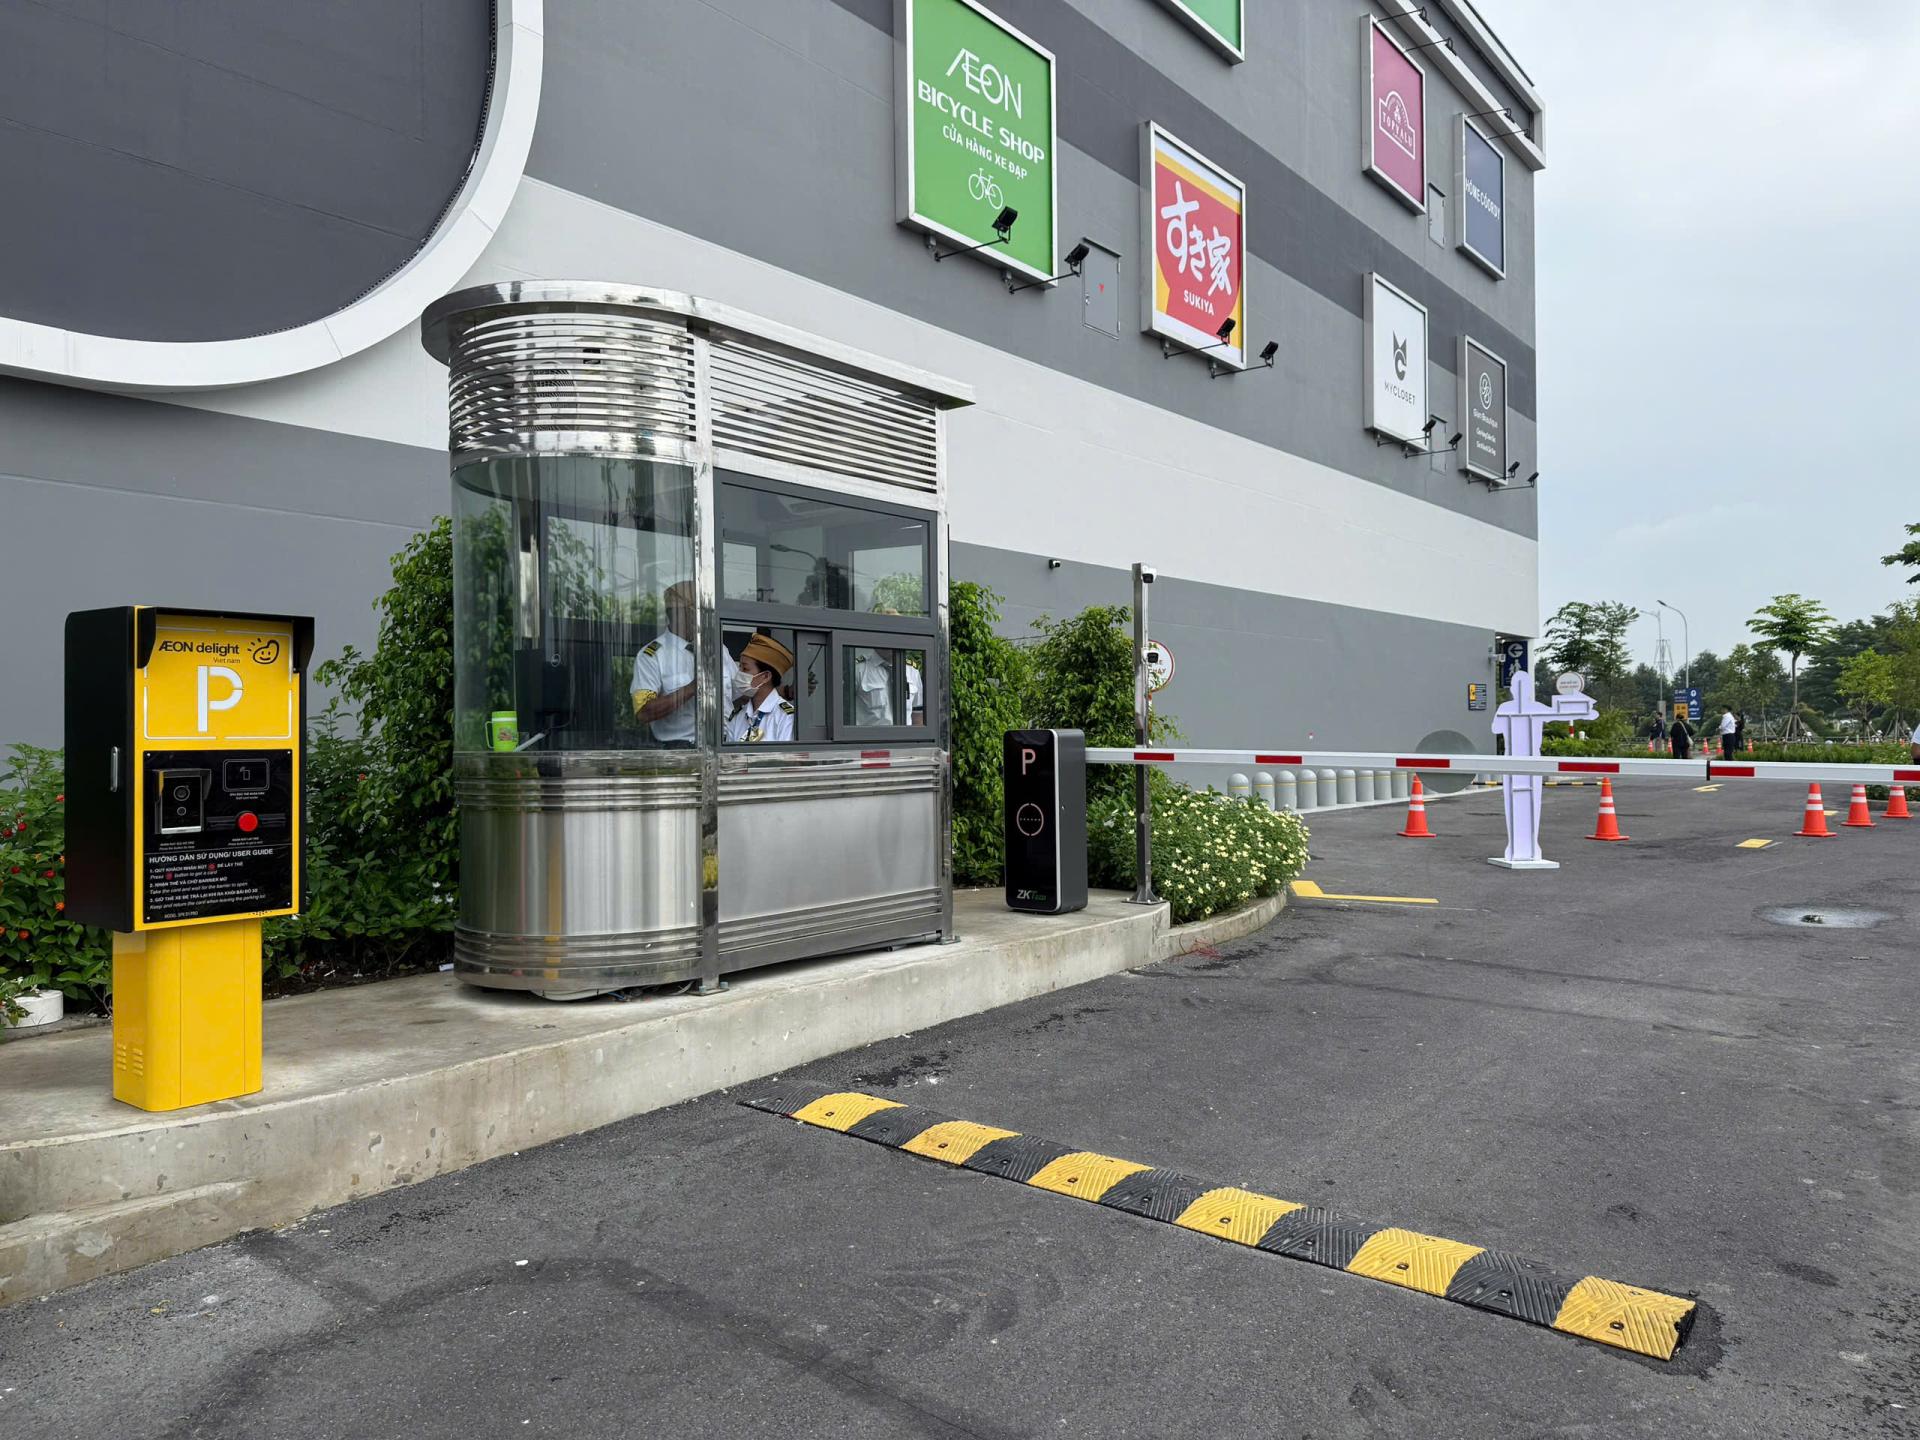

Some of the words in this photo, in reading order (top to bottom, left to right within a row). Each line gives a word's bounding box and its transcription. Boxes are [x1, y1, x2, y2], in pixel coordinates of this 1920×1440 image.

[918, 79, 993, 138] BICYCLE
[999, 128, 1045, 164] SHOP
[942, 124, 963, 146] CỬA
[966, 138, 992, 161] HÀNG
[994, 153, 1006, 170] XE
[1008, 162, 1028, 180] ĐẠP
[1161, 180, 1232, 296] すき家
[1184, 290, 1214, 316] SUKIYA
[196, 642, 240, 656] delight
[198, 666, 243, 733] P
[1022, 749, 1036, 776] P
